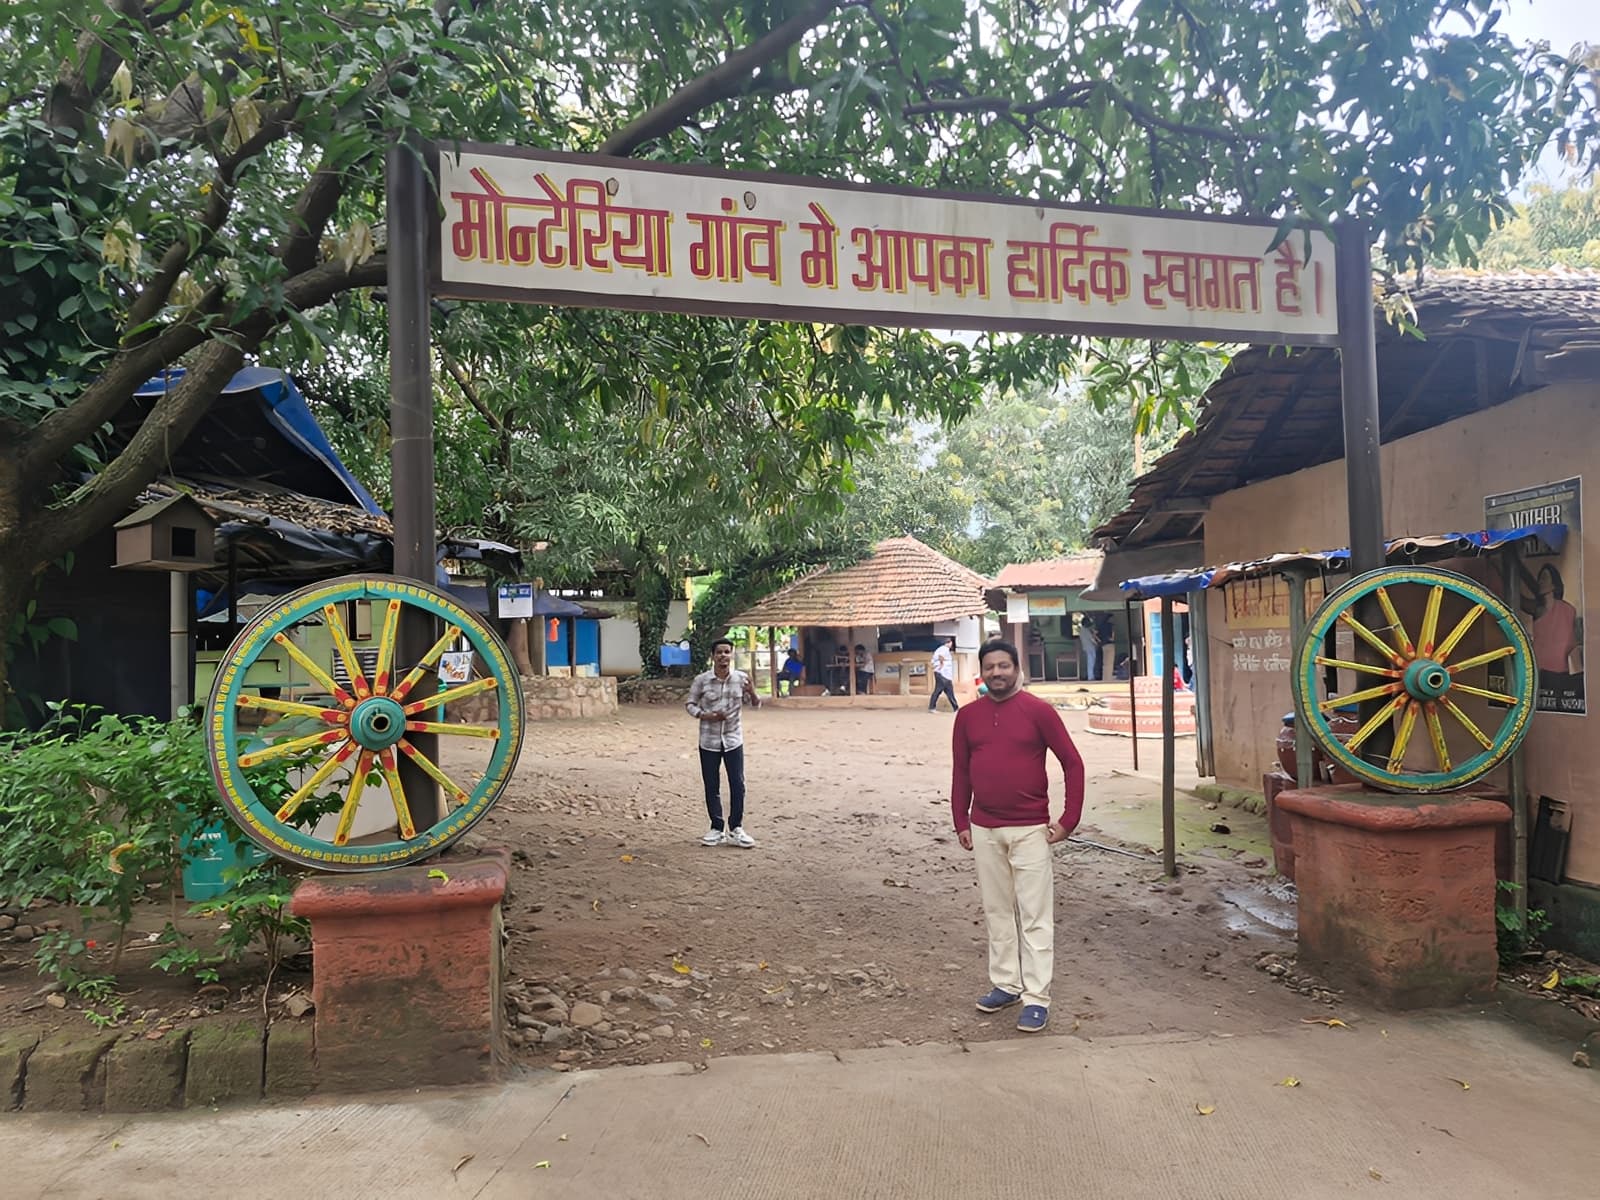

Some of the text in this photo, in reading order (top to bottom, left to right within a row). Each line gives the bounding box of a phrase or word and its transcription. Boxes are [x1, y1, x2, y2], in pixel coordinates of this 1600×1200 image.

[686, 198, 787, 288] गांव
[799, 202, 840, 289] मे
[851, 227, 995, 300] आपका
[1006, 222, 1132, 305] हार्दिक
[1142, 250, 1264, 314] स्वागत
